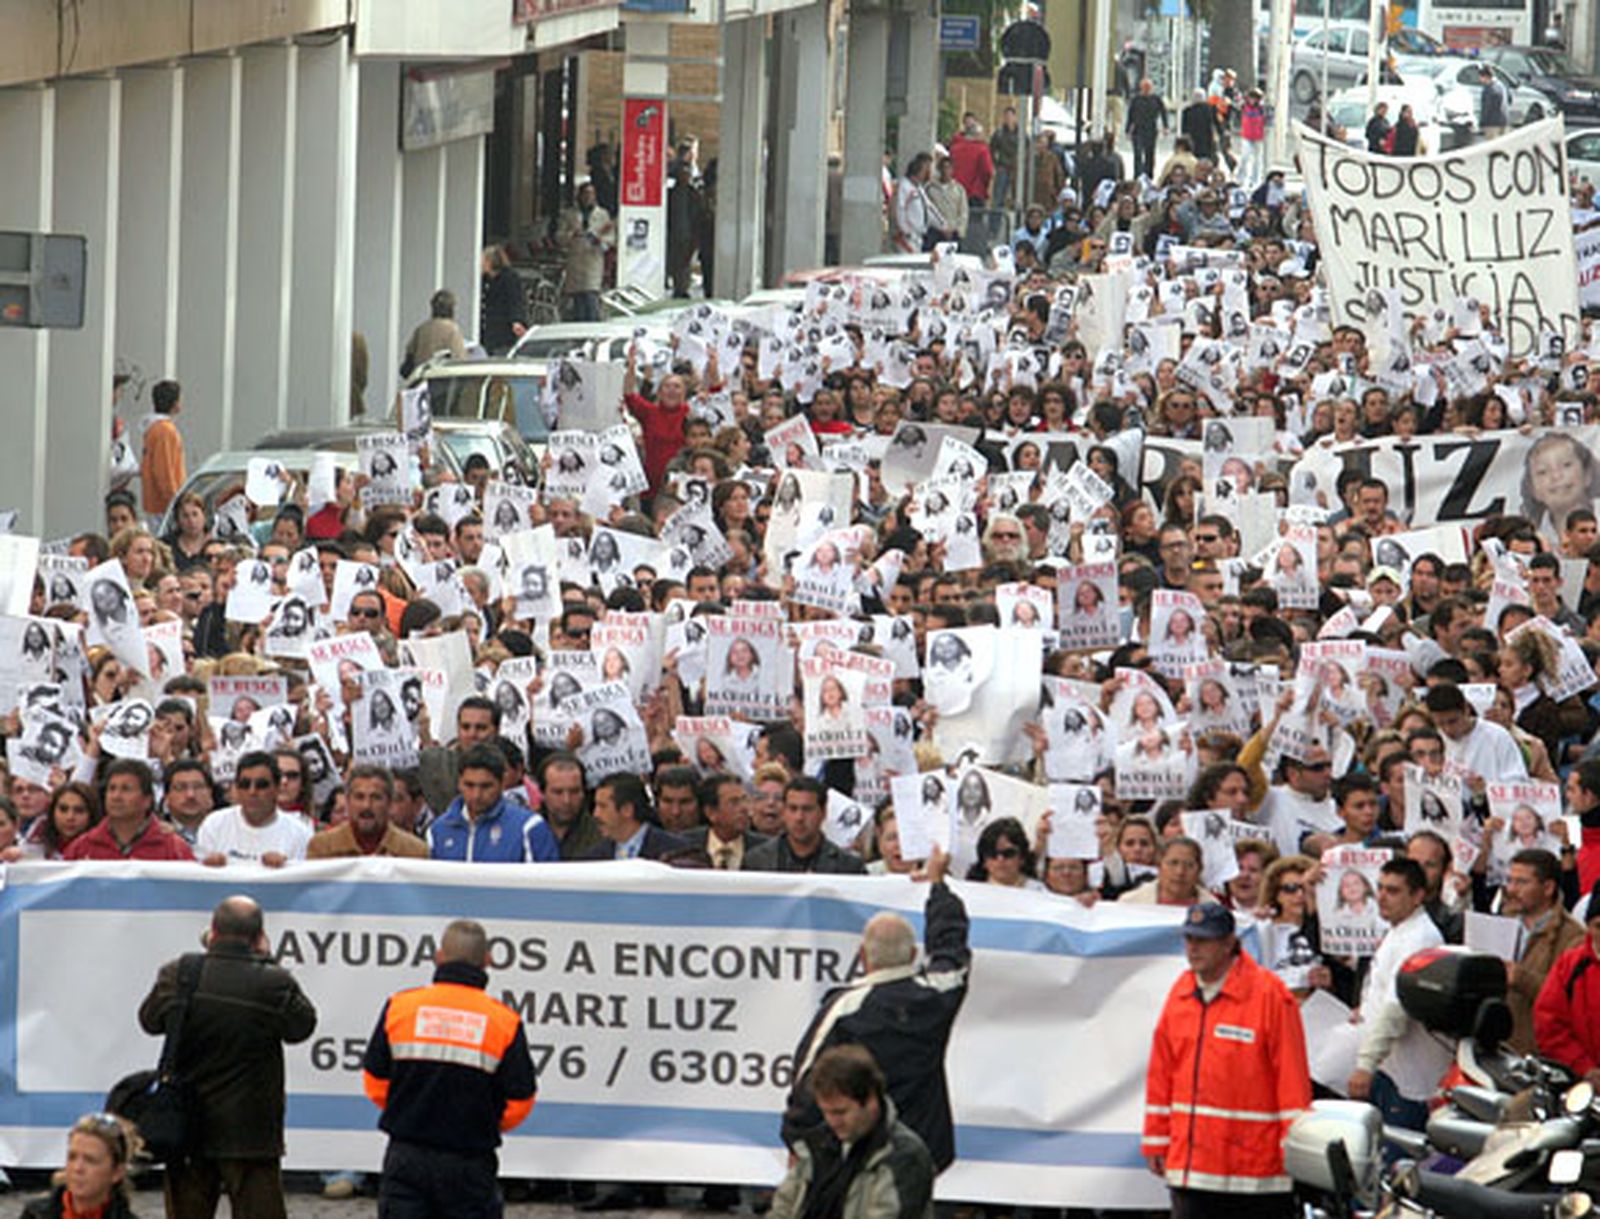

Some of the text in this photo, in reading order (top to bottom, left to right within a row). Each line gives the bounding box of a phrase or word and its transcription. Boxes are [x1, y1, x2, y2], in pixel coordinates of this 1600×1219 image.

[1301, 133, 1566, 204] TODOS CON
[1460, 210, 1561, 263] LUZ
[1277, 438, 1507, 534] UZ
[710, 618, 776, 638] SE BUSCA
[234, 679, 282, 695] BUSCA
[1488, 784, 1558, 801] SE BUSCA
[274, 928, 548, 973] AYUDAOS
[563, 940, 597, 975] A
[501, 990, 629, 1030] MARI
[647, 995, 739, 1034] LUZ
[605, 1046, 629, 1089] /
[649, 1049, 795, 1089] 63036
